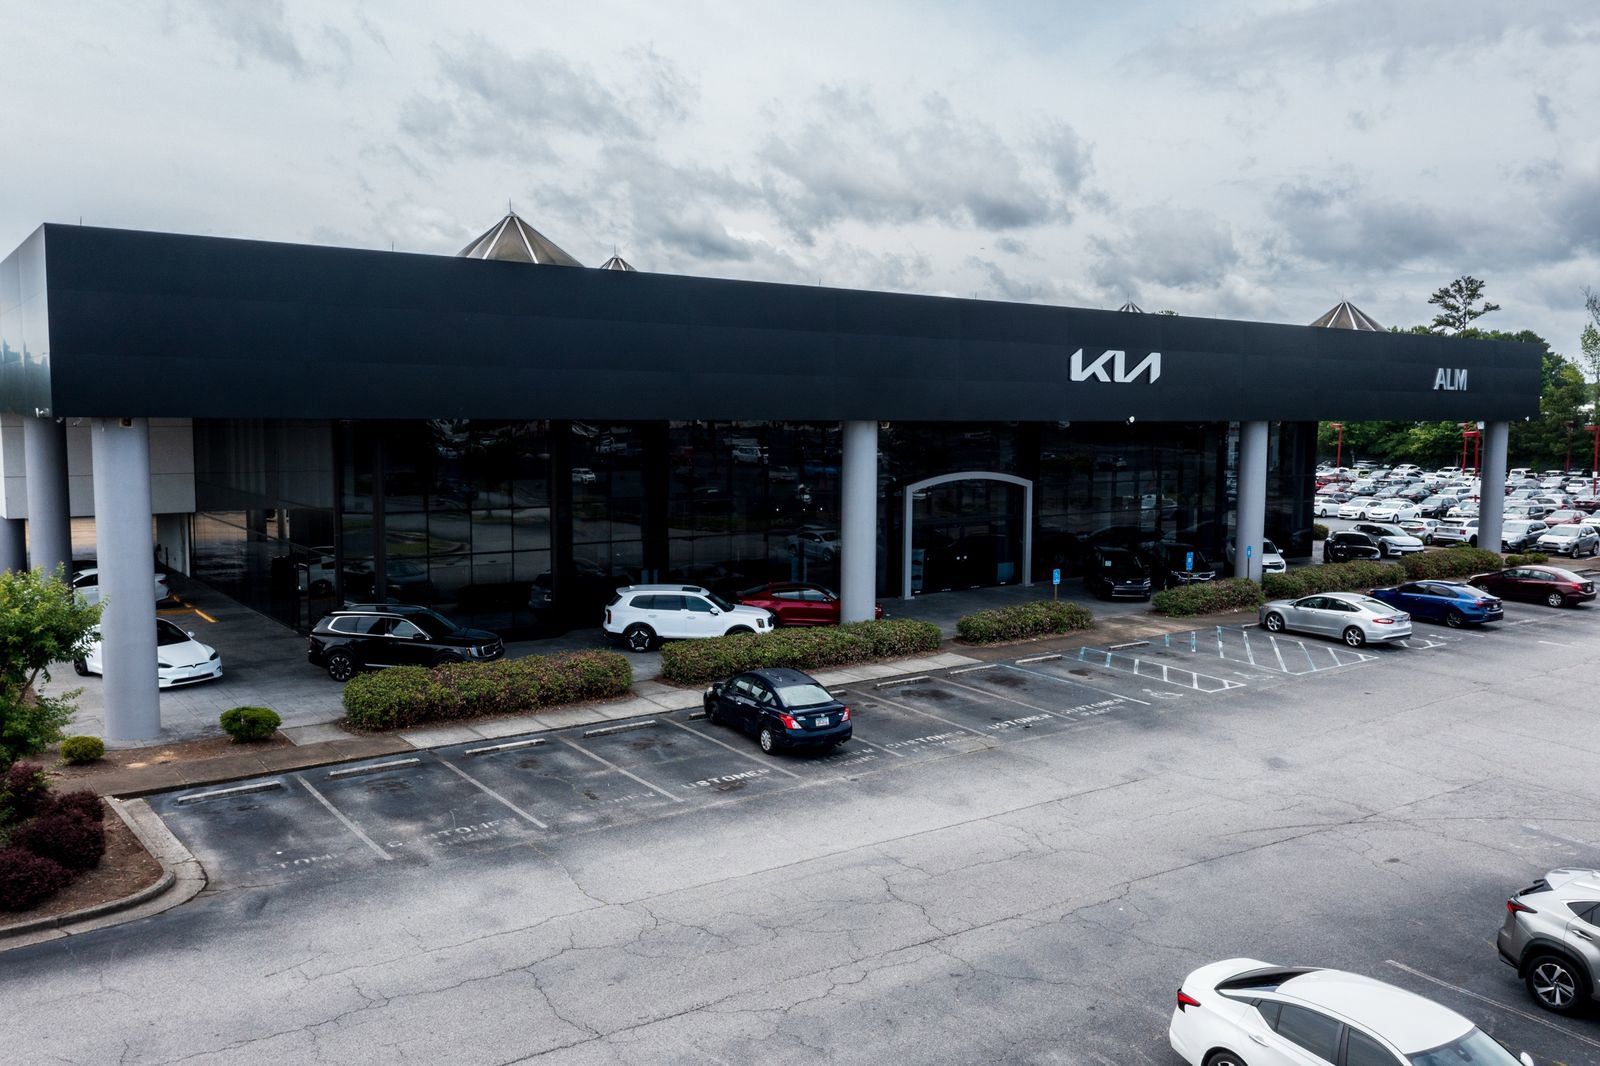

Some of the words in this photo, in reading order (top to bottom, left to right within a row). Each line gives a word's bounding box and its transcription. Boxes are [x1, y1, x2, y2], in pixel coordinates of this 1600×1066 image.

[1070, 348, 1161, 384] KIA
[1433, 367, 1468, 391] ALM
[681, 768, 771, 790] USTOMER
